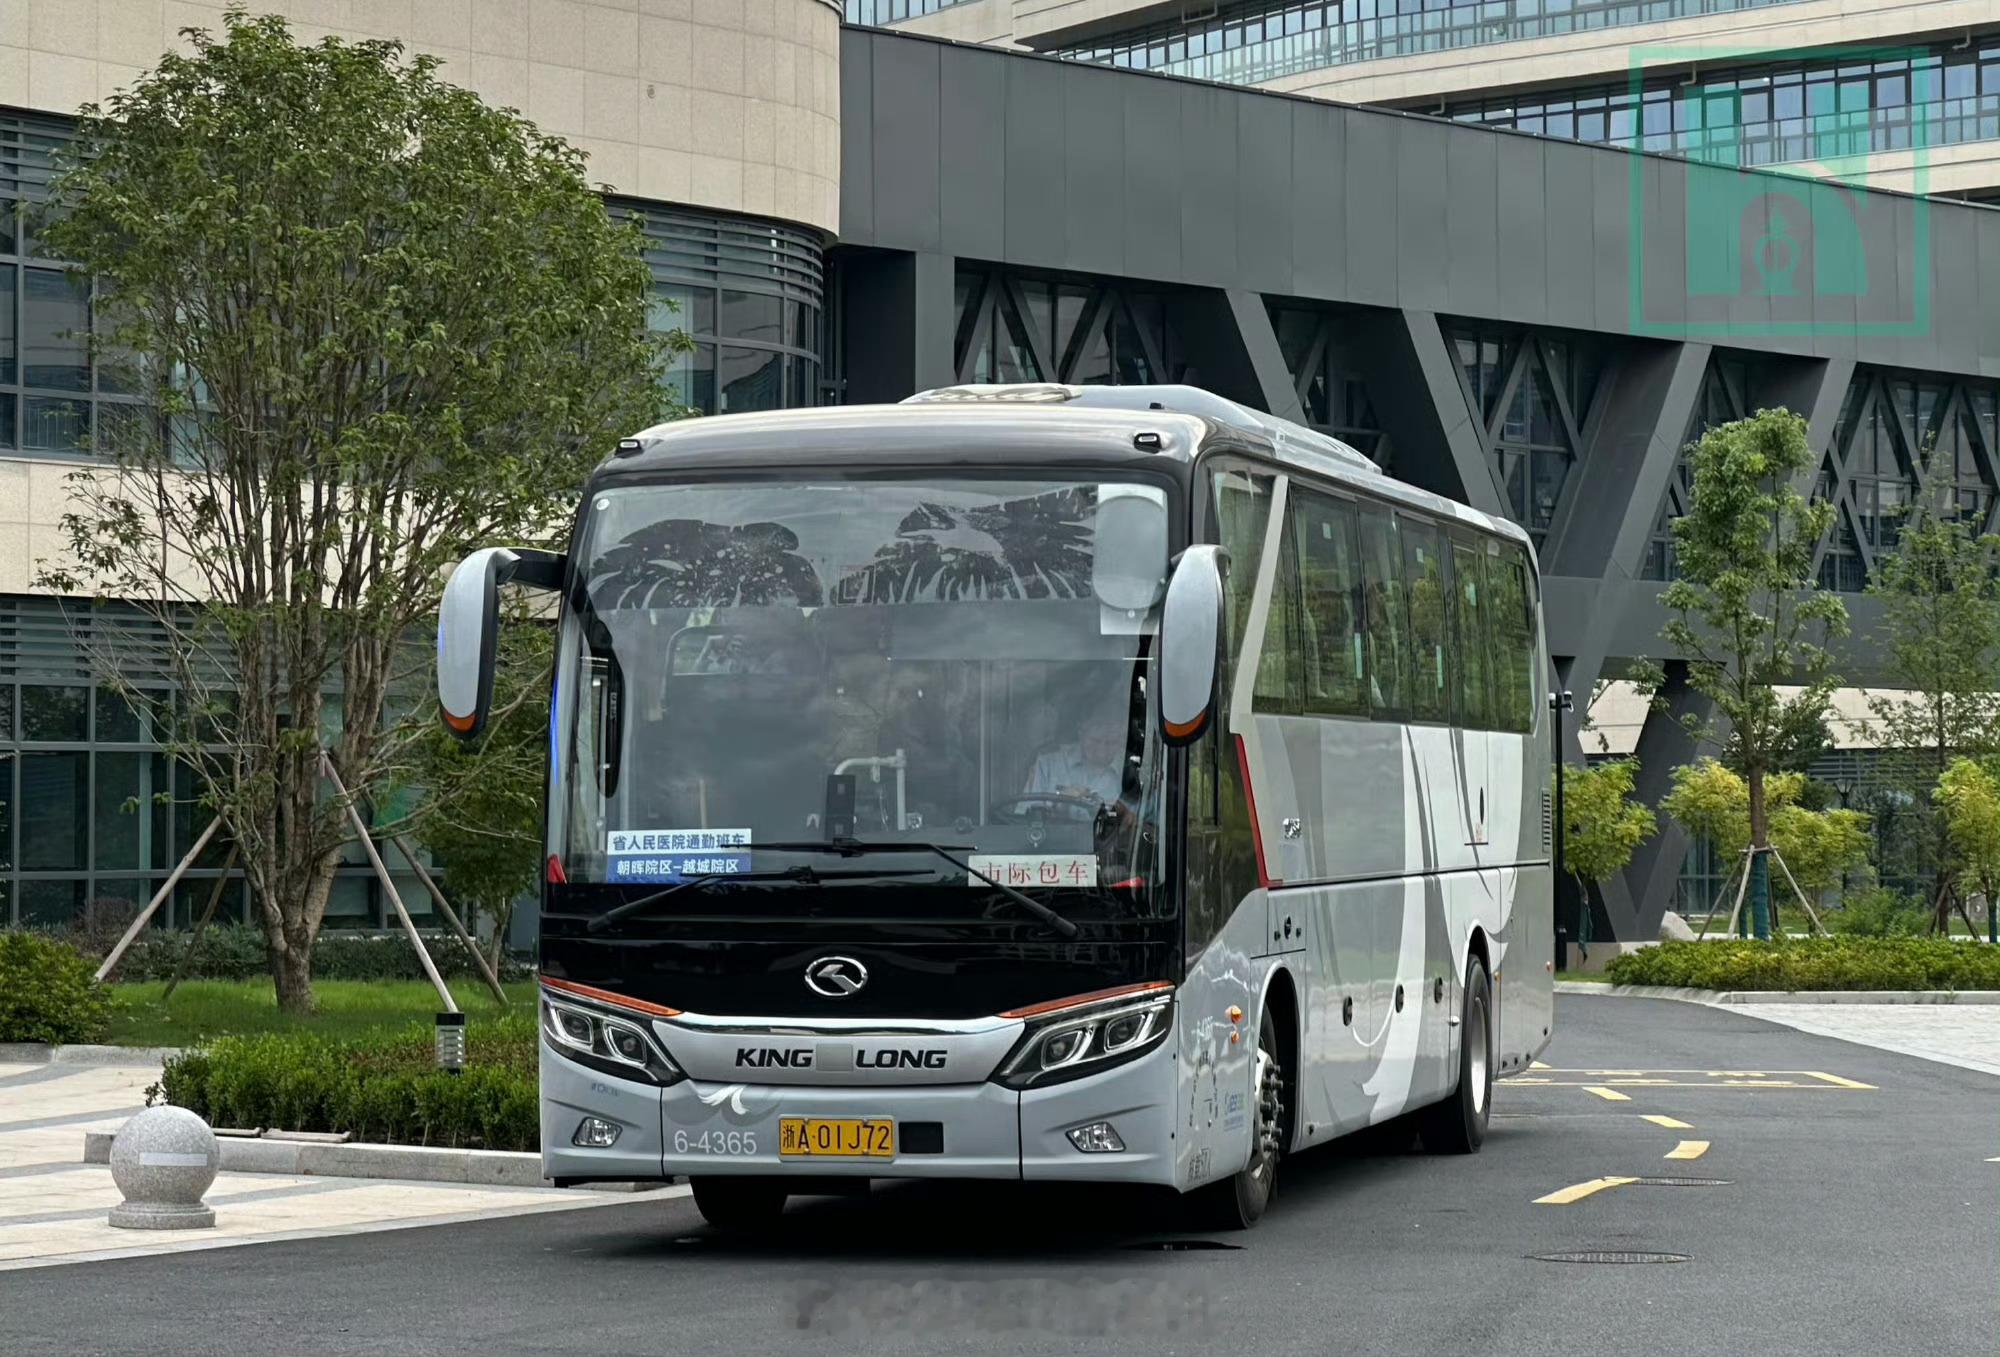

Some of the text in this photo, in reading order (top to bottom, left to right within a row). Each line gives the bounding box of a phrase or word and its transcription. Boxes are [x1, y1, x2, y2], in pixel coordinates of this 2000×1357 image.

[613, 833, 746, 850] 省人民医院通勤班车
[978, 860, 1089, 884] 市际包车
[735, 1048, 948, 1069] KING LONG
[674, 1129, 757, 1155] 6-4365
